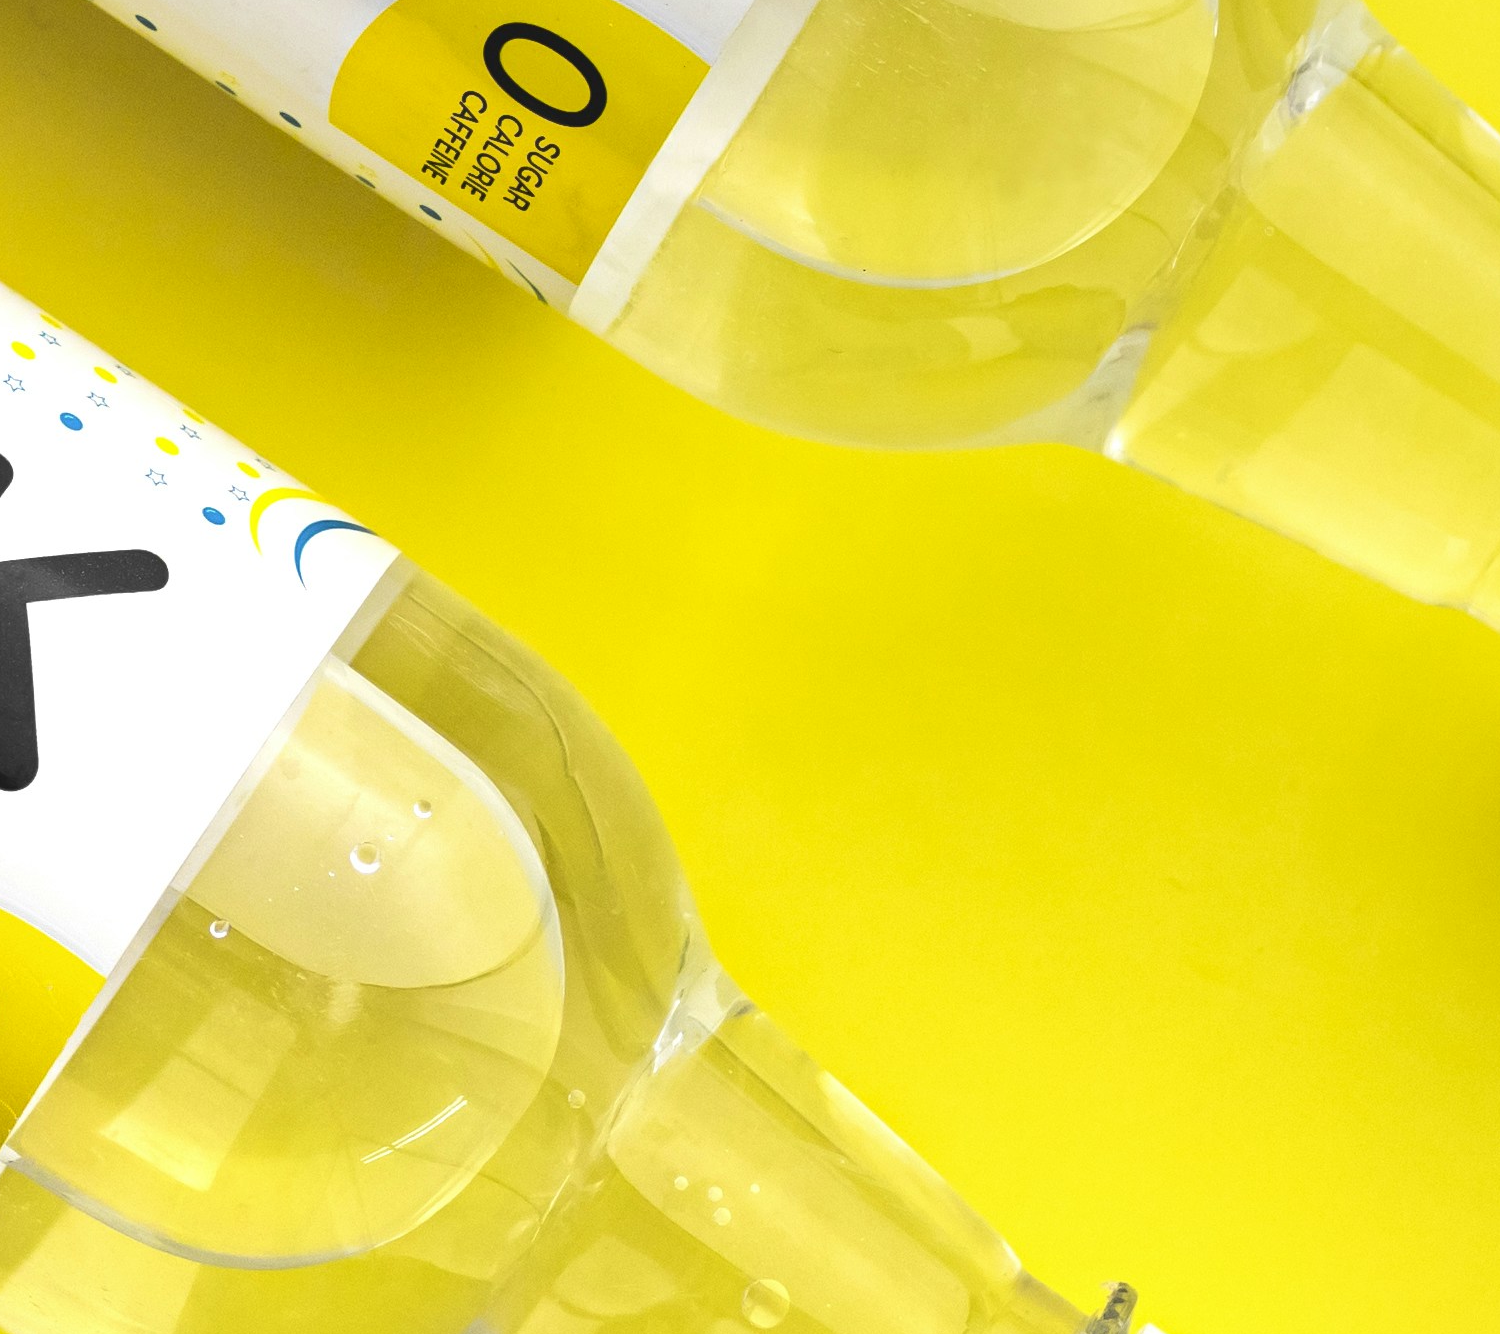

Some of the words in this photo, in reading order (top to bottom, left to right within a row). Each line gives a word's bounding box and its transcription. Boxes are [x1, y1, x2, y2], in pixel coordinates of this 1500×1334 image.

[481, 20, 609, 129] 0
[420, 89, 489, 187] CAFFEINE
[459, 113, 525, 203] CALORIE
[502, 134, 562, 213] SUGAR
